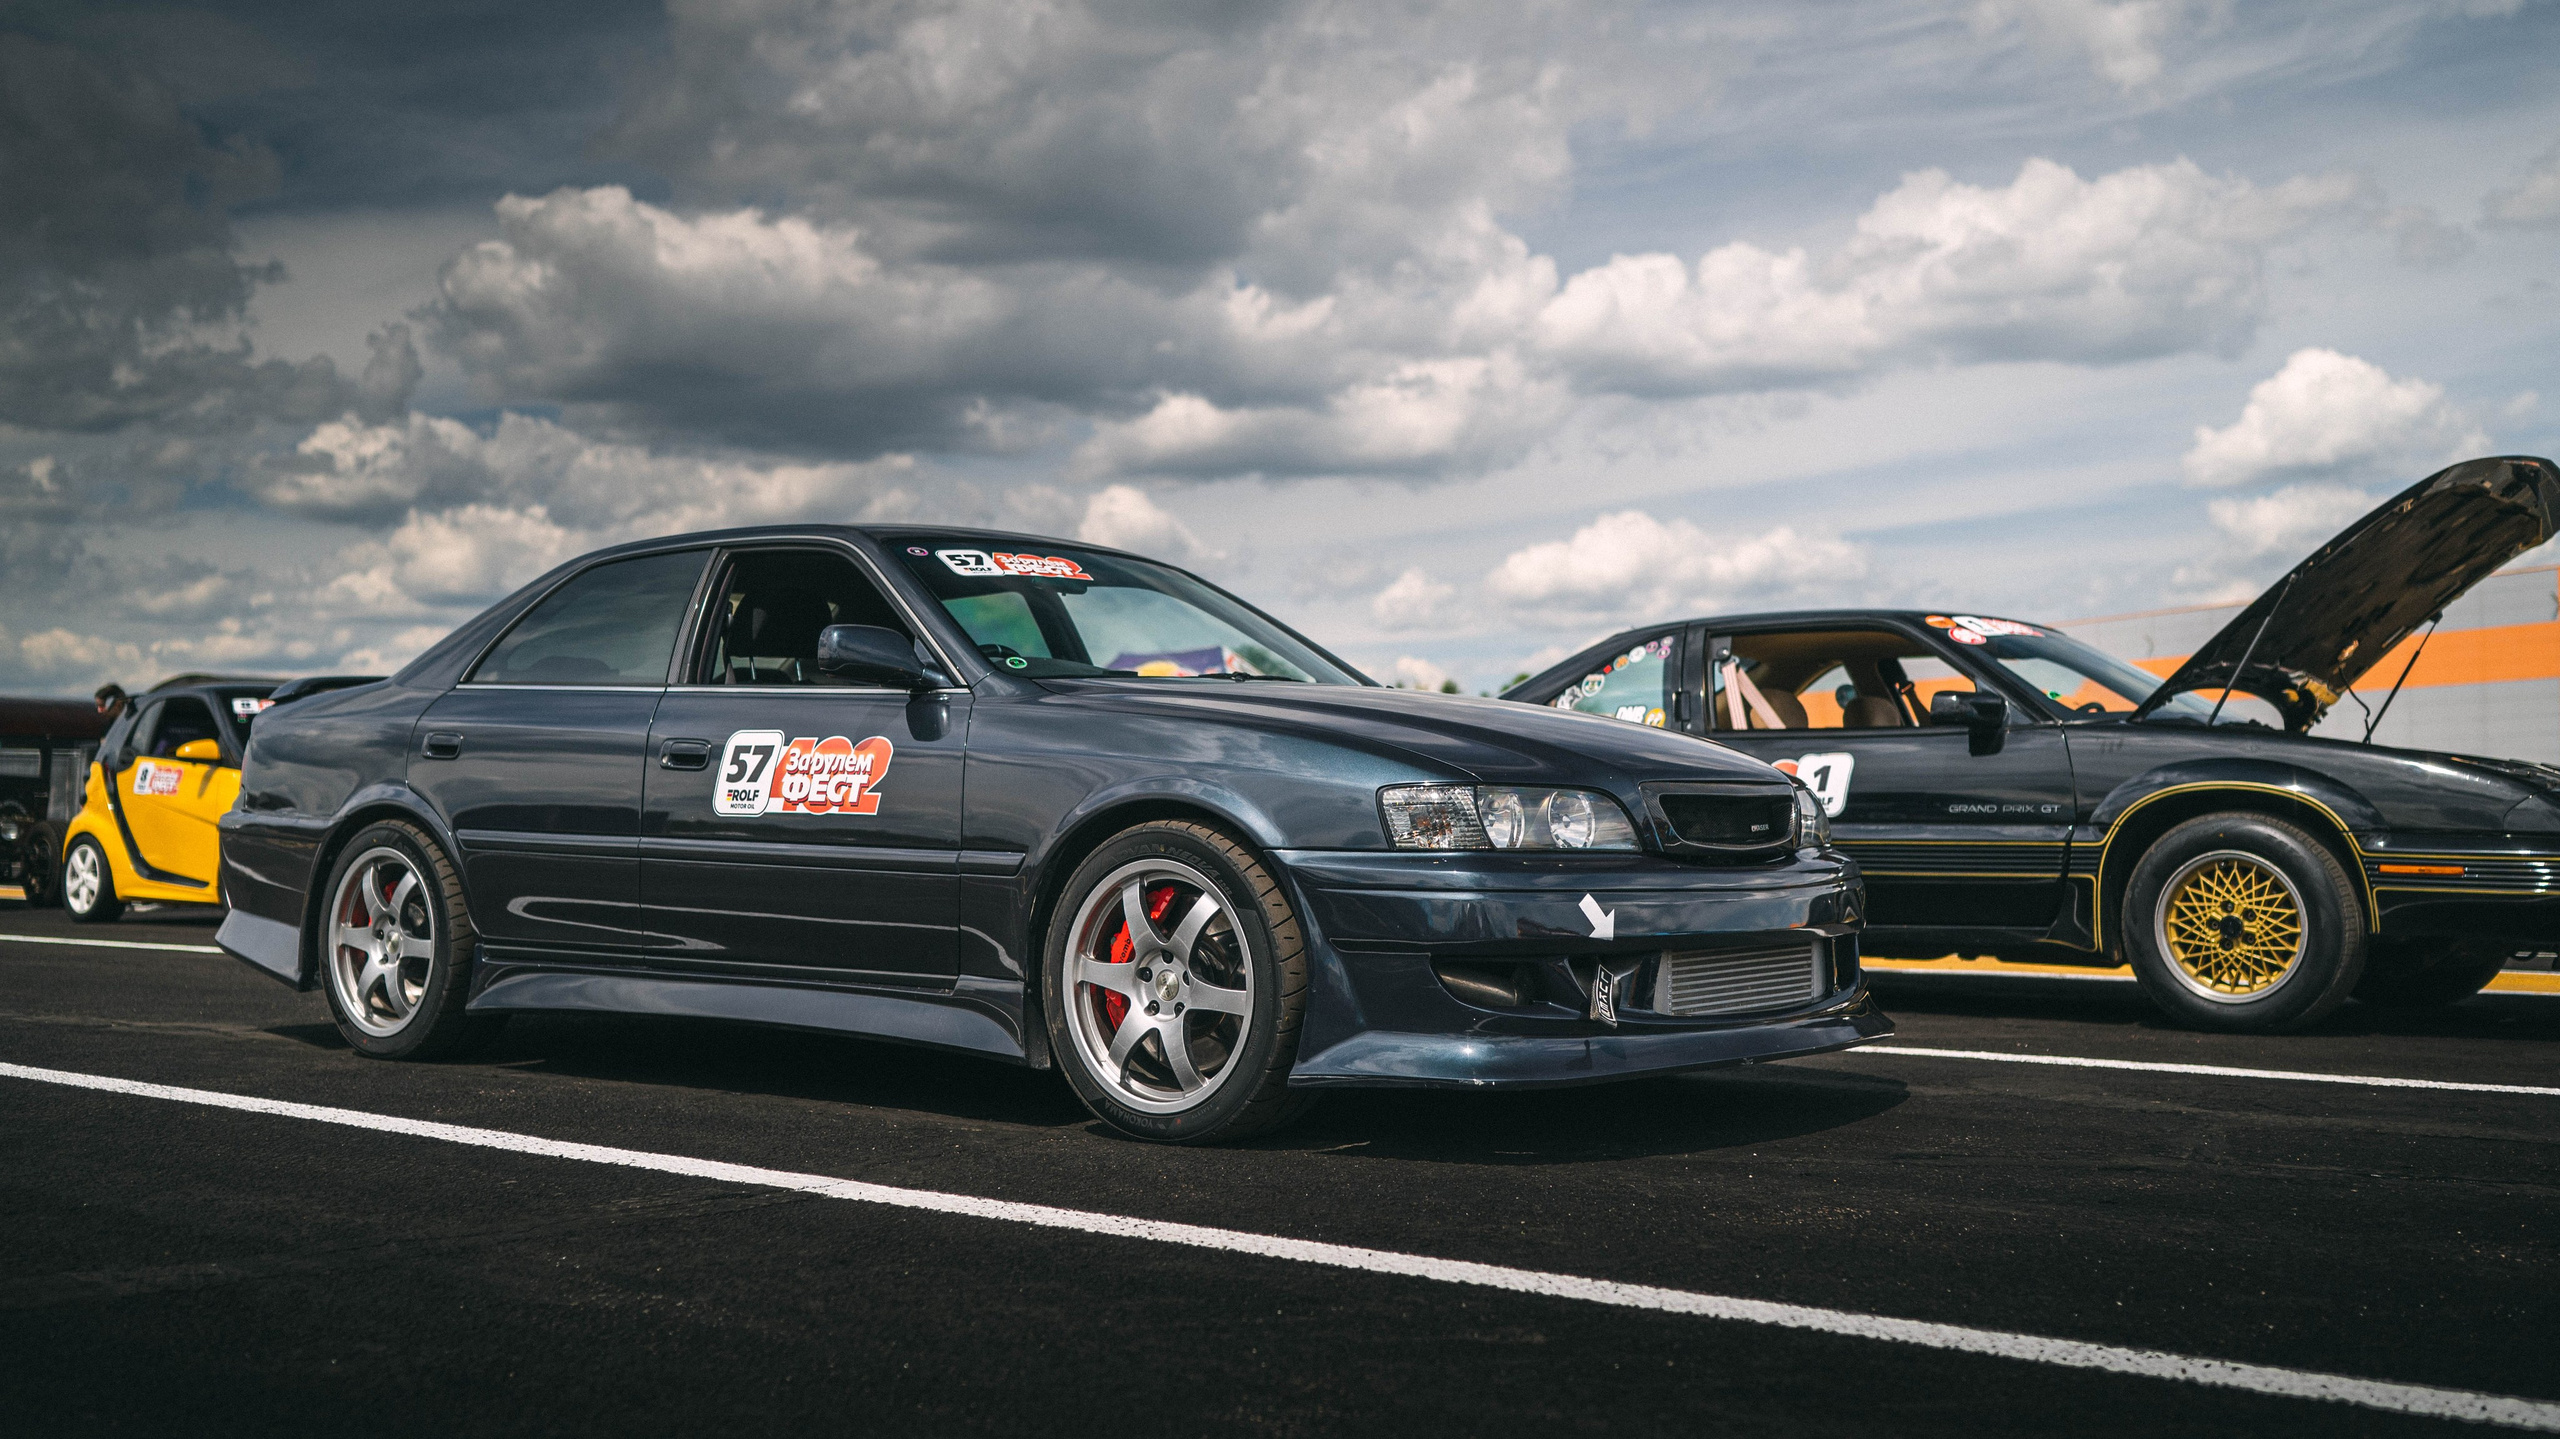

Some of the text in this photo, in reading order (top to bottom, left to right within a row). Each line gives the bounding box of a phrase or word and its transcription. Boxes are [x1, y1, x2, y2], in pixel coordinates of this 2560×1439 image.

[945, 554, 984, 566] 57
[726, 744, 775, 783] 57
[782, 773, 869, 806] ФЕСТ
[1813, 765, 1831, 792] 1
[732, 789, 760, 802] ROLF
[1948, 804, 2061, 814] GRAND PRIX GT
[1104, 1099, 1153, 1129] YOKOHAMA
